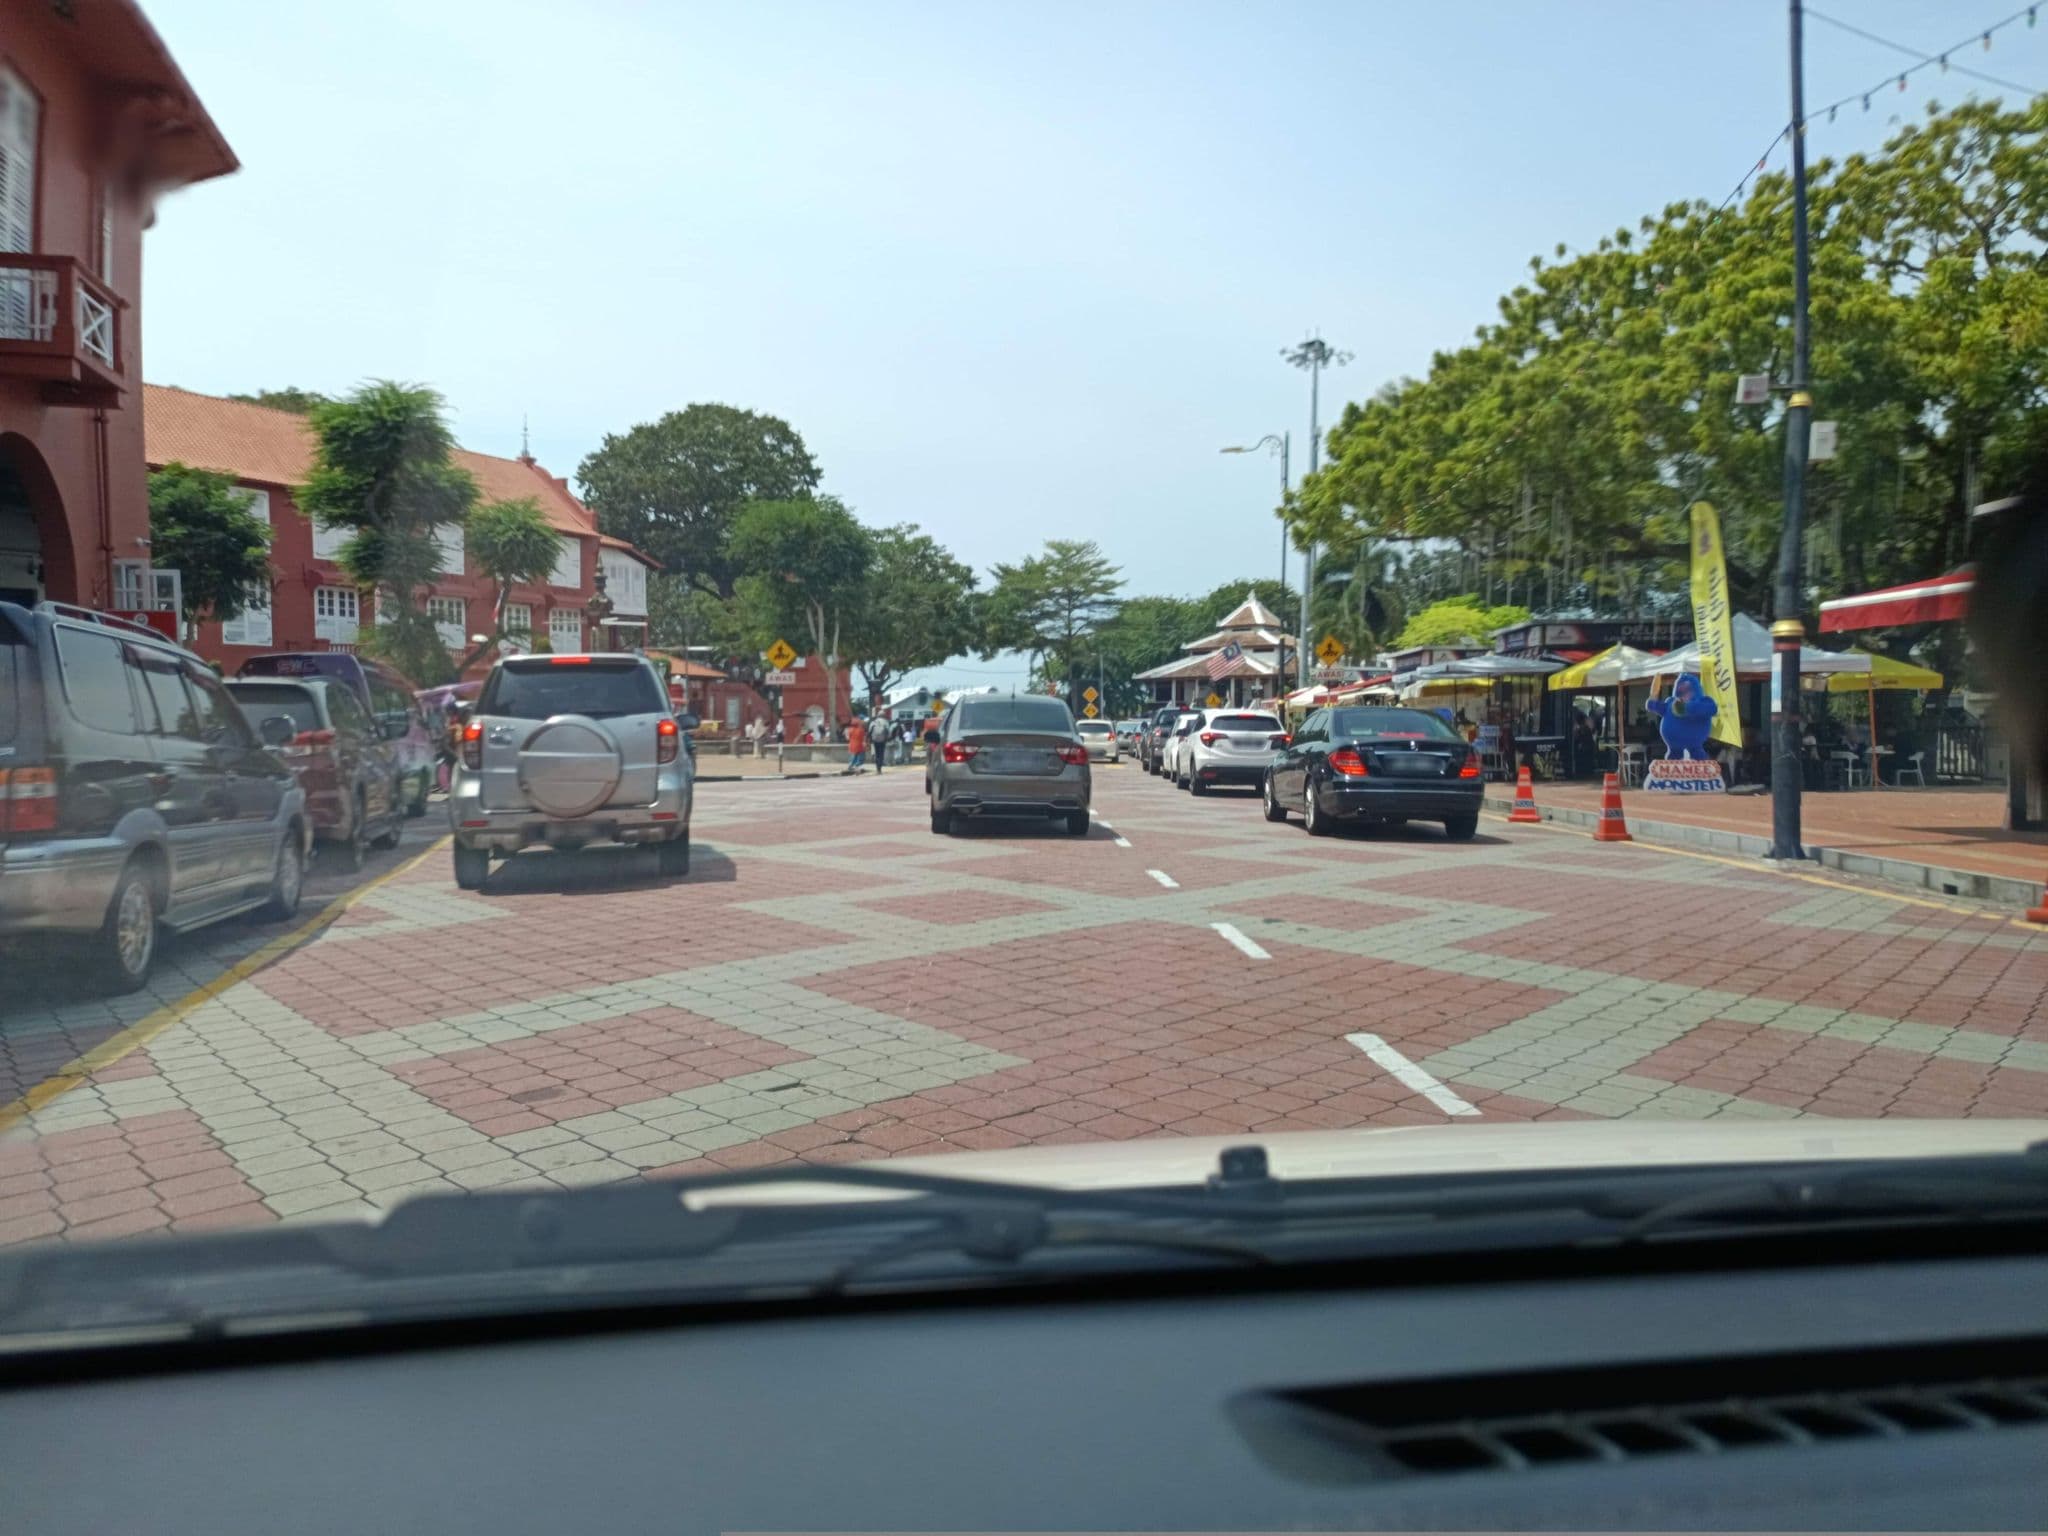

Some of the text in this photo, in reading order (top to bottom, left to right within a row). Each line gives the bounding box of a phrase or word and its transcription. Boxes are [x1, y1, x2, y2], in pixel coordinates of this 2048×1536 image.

[768, 674, 792, 682] AWAS
[1317, 670, 1342, 679] AWAS
[1660, 765, 1710, 775] MAMEE
[1648, 779, 1722, 791] MONSTER
